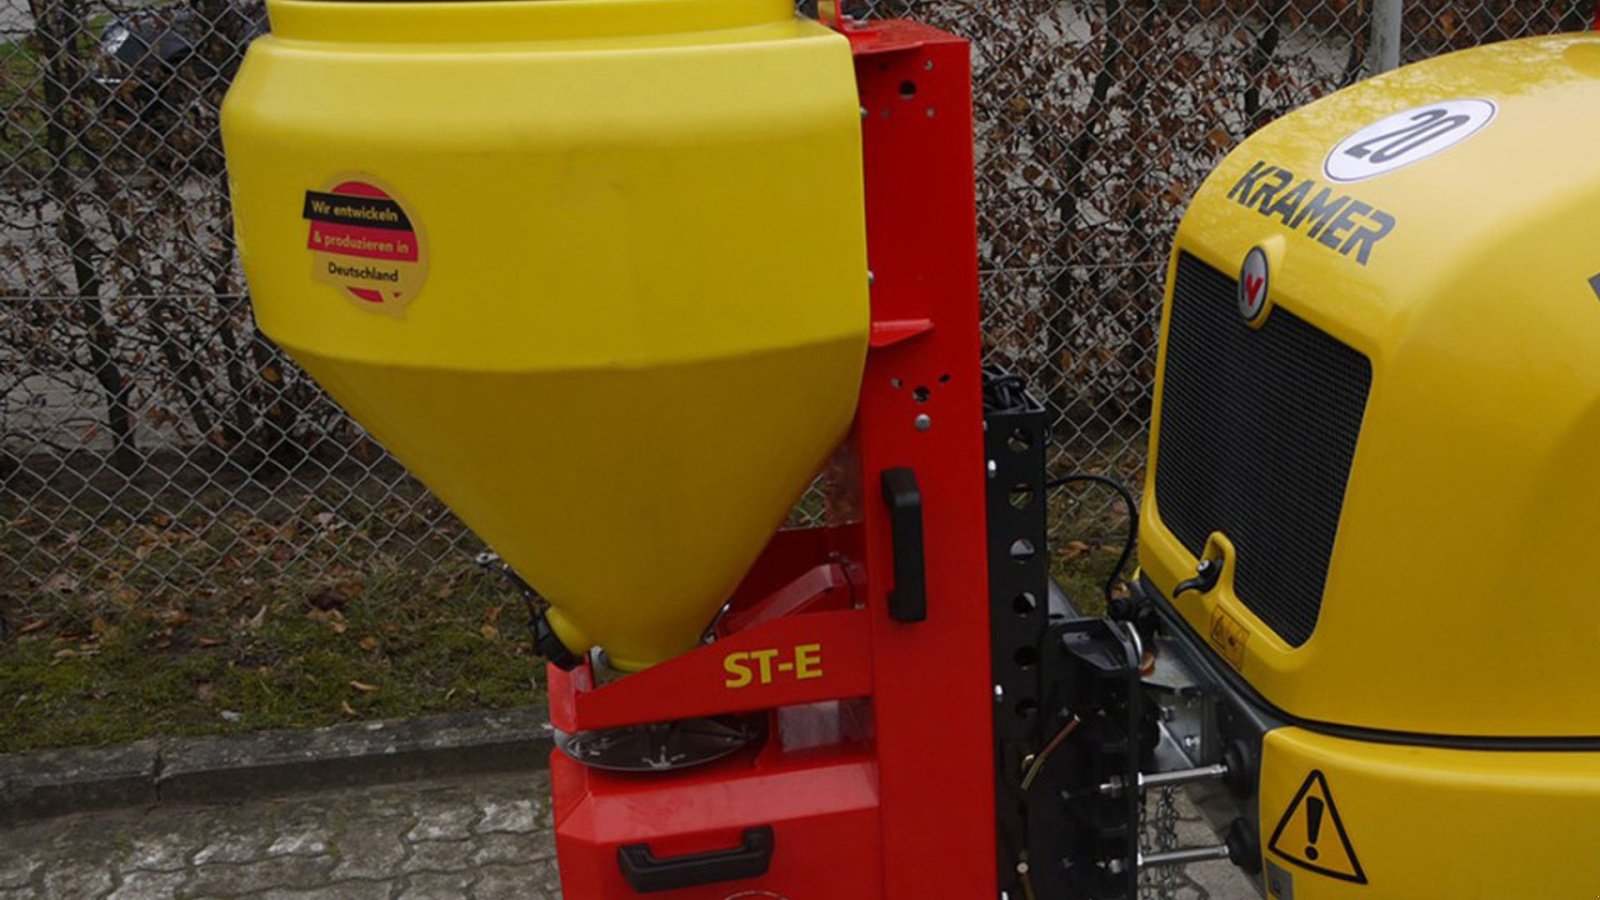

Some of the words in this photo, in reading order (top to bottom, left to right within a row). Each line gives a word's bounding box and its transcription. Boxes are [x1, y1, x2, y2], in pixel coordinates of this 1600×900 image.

[1344, 108, 1470, 164] 20
[311, 200, 331, 214] Wir
[333, 204, 398, 222] entwickeln
[1226, 160, 1396, 266] KRAMER
[313, 231, 322, 243] &
[324, 233, 394, 253] produzieren
[396, 239, 409, 254] in
[328, 261, 399, 283] Deutschland
[723, 643, 823, 689] ST-E
